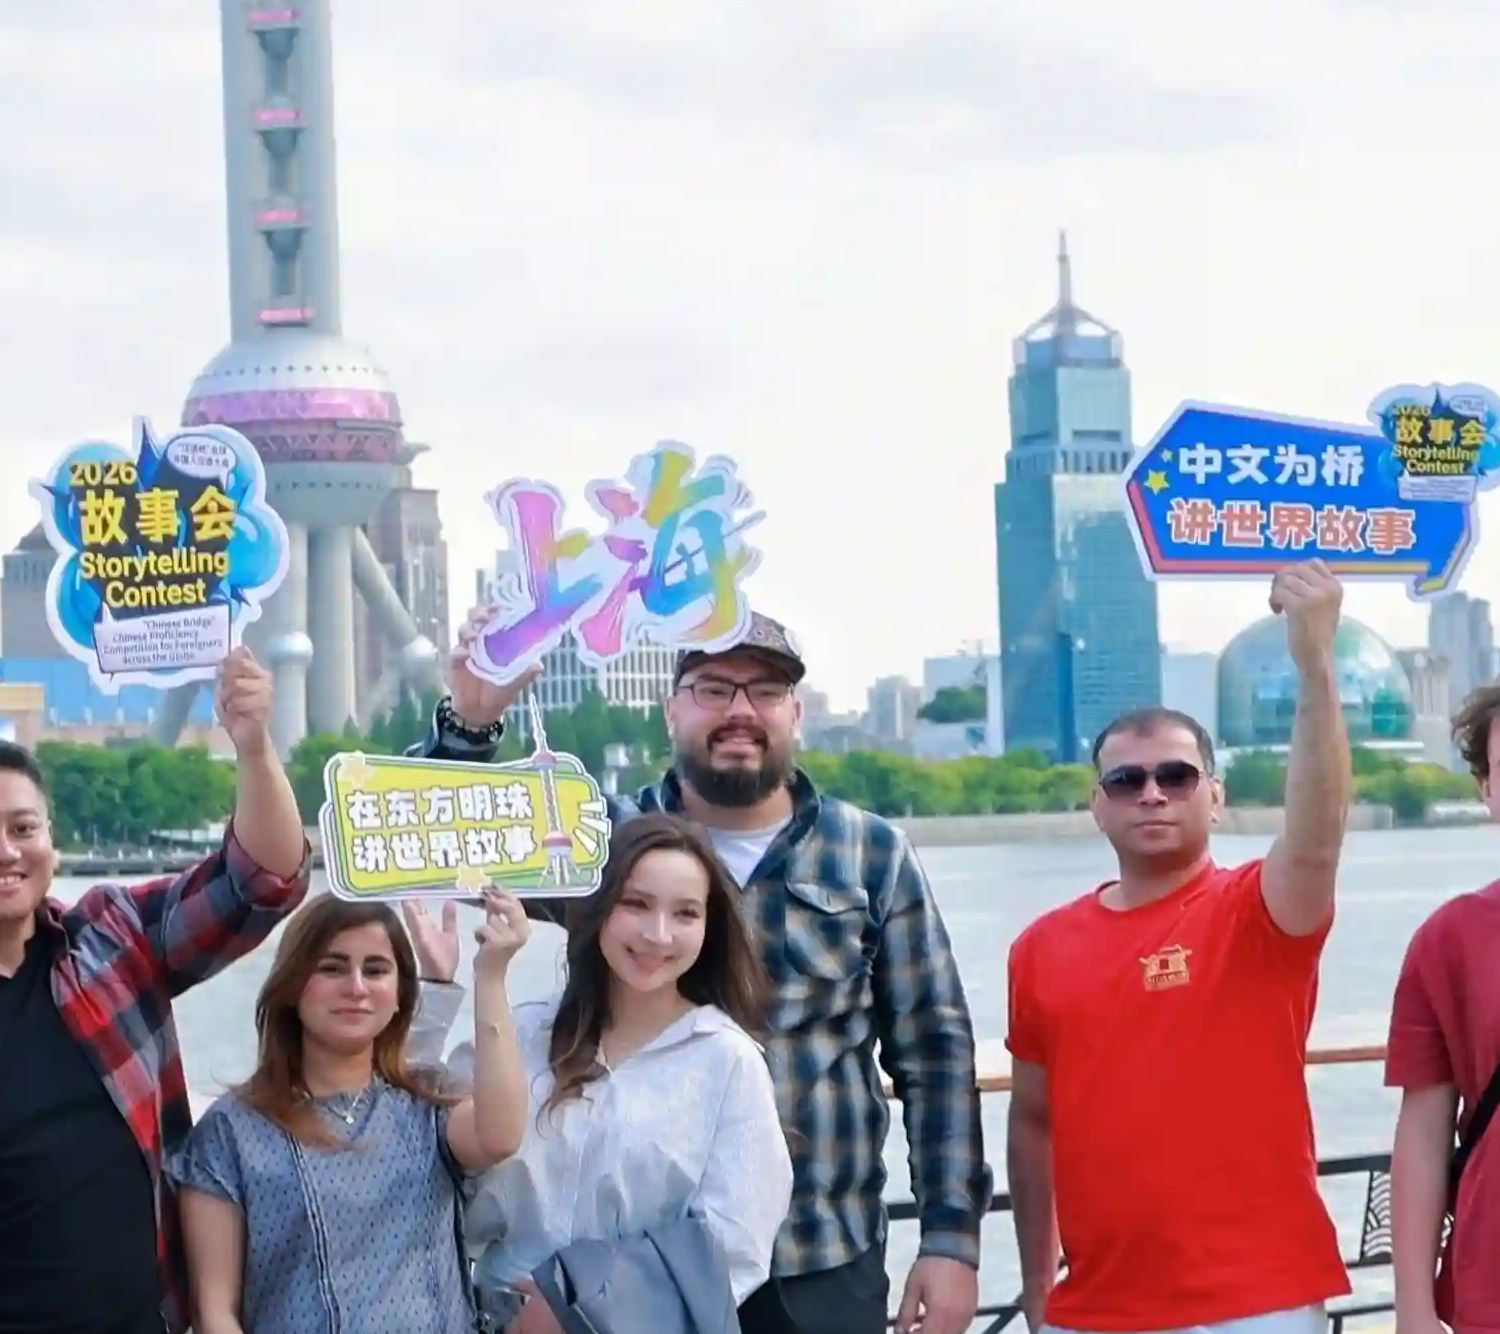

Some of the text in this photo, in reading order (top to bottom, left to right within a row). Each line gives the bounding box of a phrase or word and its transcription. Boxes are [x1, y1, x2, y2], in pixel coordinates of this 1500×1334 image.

[69, 460, 138, 487] 2026
[1178, 443, 1365, 488] 中文为桥
[1406, 459, 1465, 474] Contest
[79, 485, 238, 546] 故事会
[1167, 496, 1418, 555] 讲世界故事
[79, 547, 230, 583] Storytelling
[482, 448, 744, 667] 上海
[105, 579, 207, 609] Contest
[347, 782, 535, 829] 在东方明珠
[352, 823, 537, 875] 讲世界故事
